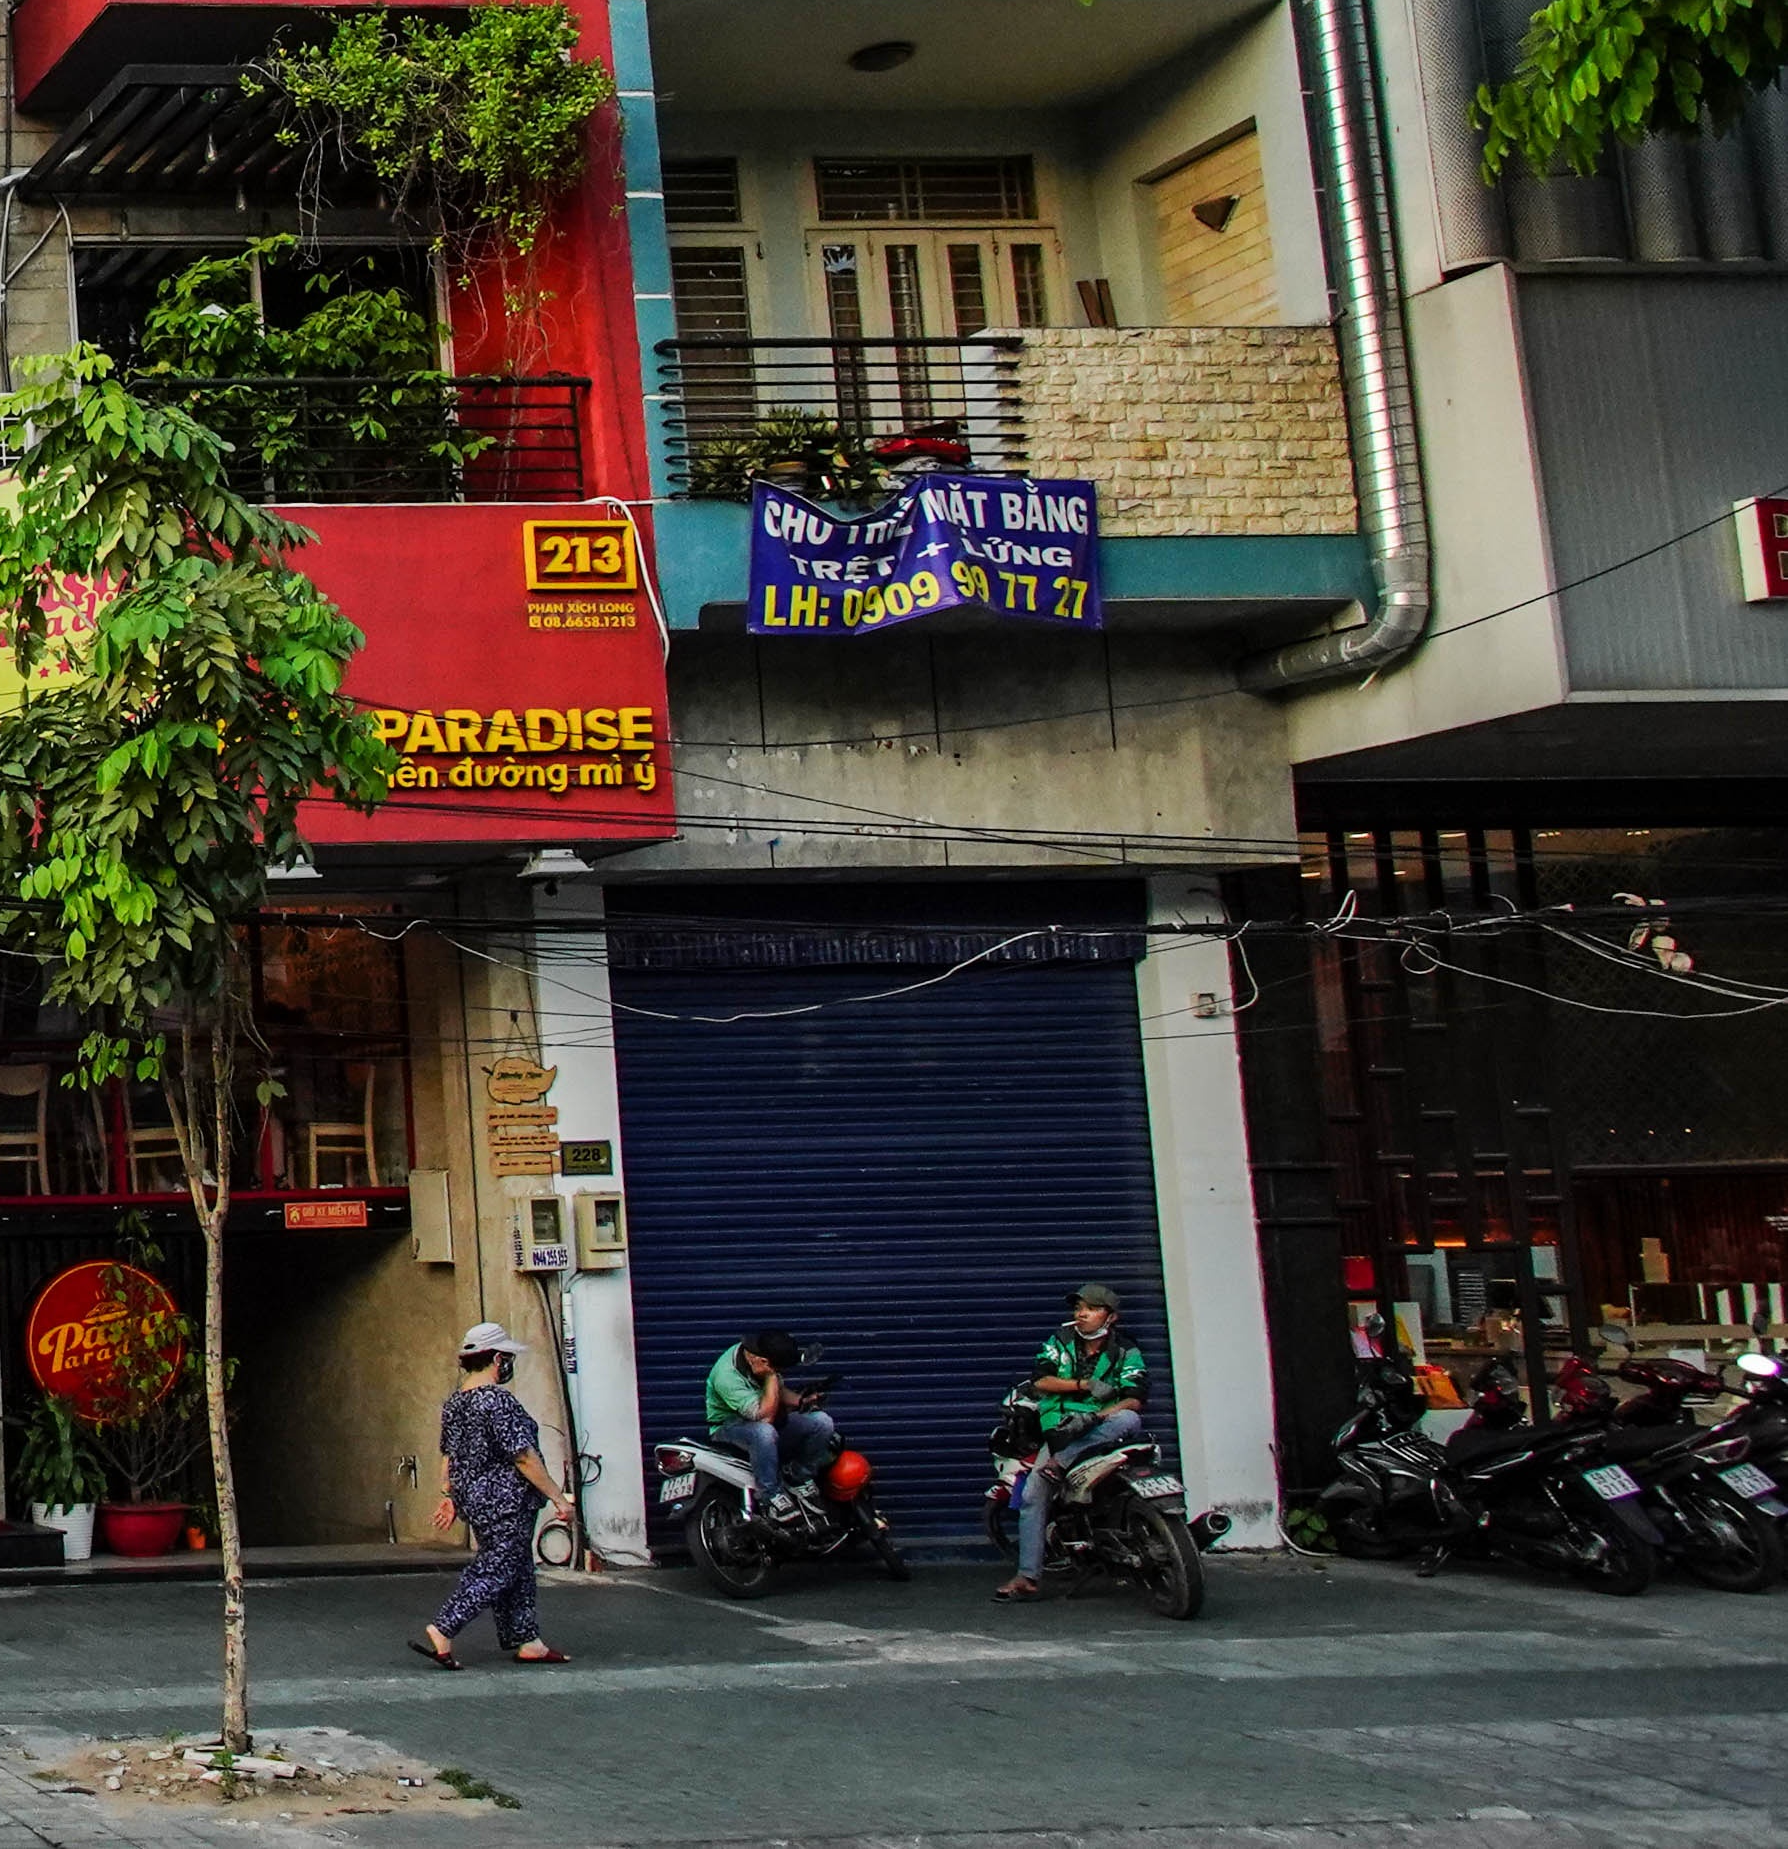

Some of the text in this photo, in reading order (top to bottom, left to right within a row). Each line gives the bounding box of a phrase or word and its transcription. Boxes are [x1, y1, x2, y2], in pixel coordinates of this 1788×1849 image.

[1000, 478, 1088, 535] BẰNG
[540, 535, 622, 575] 213
[527, 602, 564, 615] PHAN
[599, 602, 636, 615] LONG
[764, 560, 1089, 628] LH: 0909 99 77 27
[542, 616, 637, 629] 08.6658.1213
[373, 707, 655, 753] PARADISE
[448, 755, 569, 793] đường
[633, 752, 657, 792] ý
[571, 1148, 602, 1162] 228
